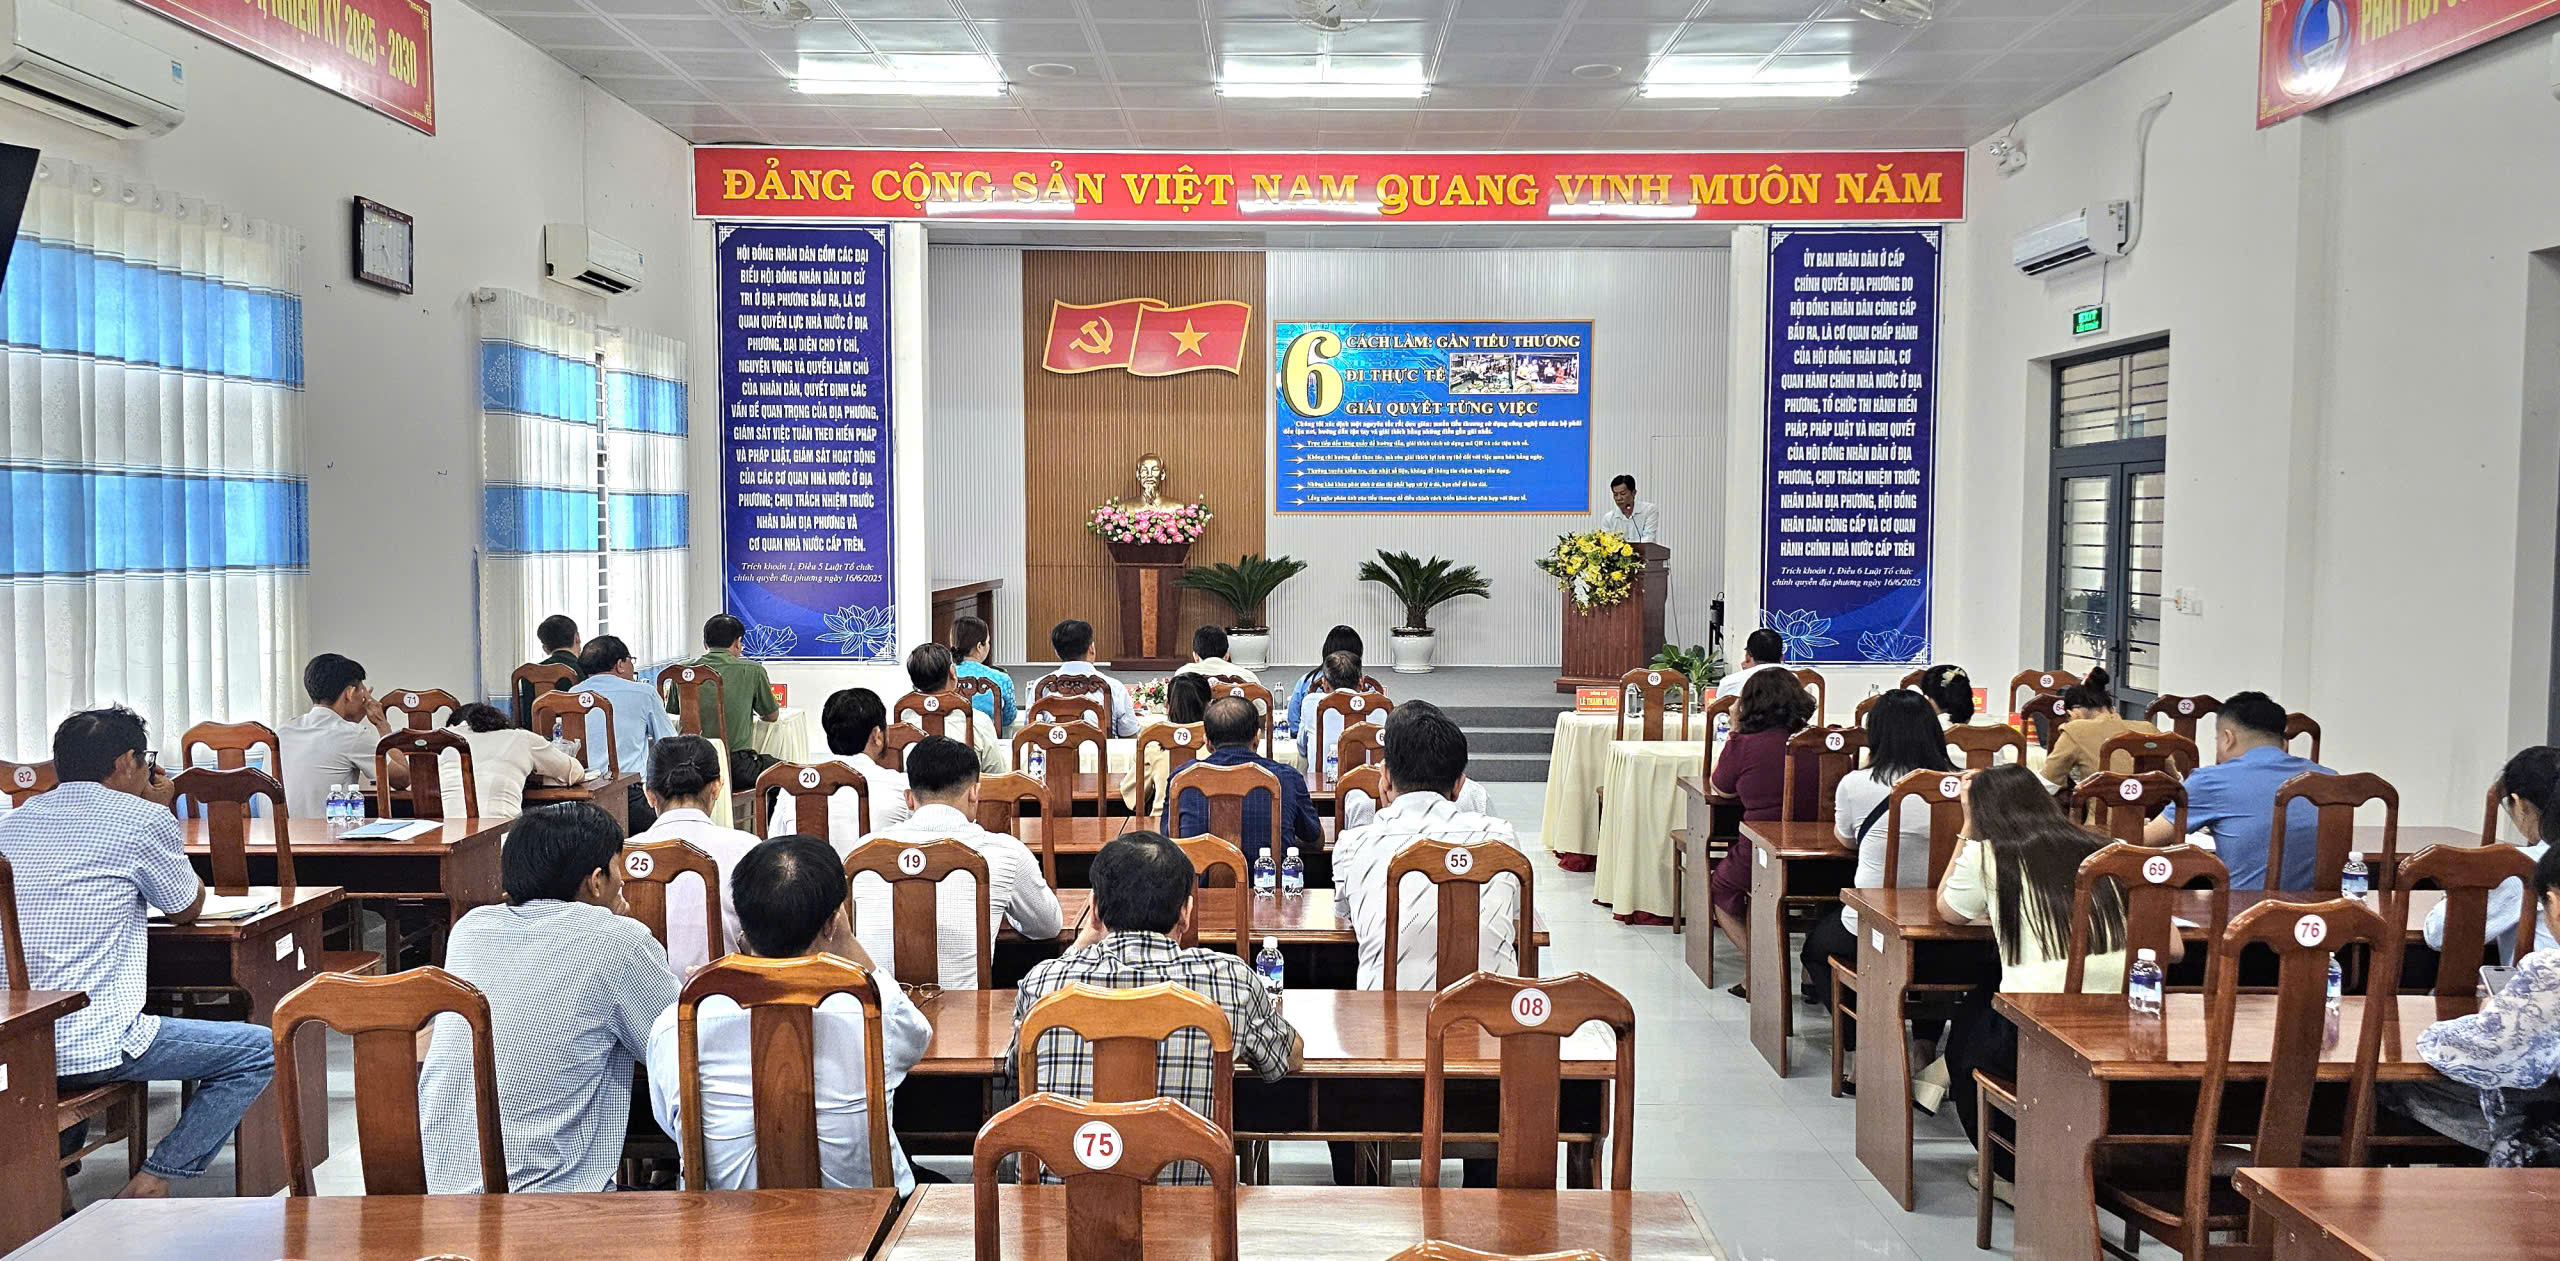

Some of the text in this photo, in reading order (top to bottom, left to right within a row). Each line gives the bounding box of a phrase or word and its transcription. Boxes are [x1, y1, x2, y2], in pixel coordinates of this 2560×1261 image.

[345, 4, 377, 66] 2025
[388, 28, 417, 88] 2030
[723, 158, 1942, 216] ĐẢNG CỘNG SẢN VIỆT NAM QUANG VINH MUÔN NĂM
[737, 244, 750, 263] HỘI
[776, 245, 797, 261] NHÂN
[800, 245, 815, 262] DÂN
[838, 246, 853, 262] CÁC
[855, 249, 868, 265] ĐẠI
[1804, 248, 1904, 267] ỦY BAN NHÂN DÂN Ở CẤP
[741, 264, 758, 283] BIỂU
[761, 267, 774, 287] HỘI
[799, 268, 821, 284] NHÂN
[824, 268, 839, 284] DÂN
[842, 271, 851, 285] DO
[854, 267, 865, 285] CỬ
[1795, 274, 1820, 292] CHÍNH
[1851, 277, 1864, 295] ĐỊA
[1866, 275, 1900, 291] PHƯƠNG
[1902, 277, 1913, 291] DO
[740, 292, 752, 306] TRI
[755, 288, 760, 306] Ở
[762, 292, 775, 309] ĐỊA
[778, 291, 808, 307] PHƯƠNG
[829, 293, 841, 309] RA,
[844, 291, 853, 307] LÀ
[855, 293, 866, 307] CƠ
[1790, 298, 1804, 319] HỘI
[1831, 298, 1854, 316] NHÂN
[1856, 298, 1873, 316] DÂN
[1876, 298, 1897, 316] CÙNG
[1900, 296, 1916, 316] CẤP
[739, 314, 759, 330] QUAN
[789, 314, 803, 332] LỰC
[806, 313, 822, 329] NHÀ
[824, 313, 845, 330] NƯỚC
[847, 312, 852, 330] Ở
[855, 316, 868, 333] ĐỊA
[1807, 326, 1820, 341] RA,
[1822, 323, 1832, 340] LÀ
[1834, 324, 1846, 340] CƠ
[1847, 325, 1869, 341] QUAN
[1872, 321, 1893, 340] CHẤP
[1895, 323, 1918, 340] HÀNH
[1346, 331, 1580, 348] CÁCH LÀM: GẦN TIỂU THƯƠNG
[1794, 345, 1810, 364] CỦA
[1813, 347, 1826, 367] HỘI
[1853, 347, 1876, 364] NHÂN
[1878, 347, 1897, 366] DÂN,
[1900, 348, 1911, 364] CƠ
[1281, 329, 1344, 418] 6
[1345, 366, 1446, 384] ĐI THỰC TẾ
[1345, 398, 1538, 416] GIẢI QUYẾT TỪNG VIỆC
[846, 574, 882, 582] 16/6/2025
[407, 696, 416, 704] 71
[581, 696, 591, 704] 24
[1353, 699, 1362, 707] 73
[1052, 730, 1064, 740] 56
[1177, 731, 1188, 741] 79
[1829, 736, 1841, 746] 78
[18, 771, 32, 782] 82
[803, 772, 816, 783] 20
[1944, 781, 1958, 792] 57
[2124, 784, 2138, 795] 28
[630, 856, 649, 872] 25
[903, 854, 921, 868] 19
[1450, 854, 1468, 868] 55
[2149, 863, 2166, 876] 69
[2301, 922, 2320, 938] 76
[1519, 997, 1543, 1017] 08
[1082, 1133, 1113, 1156] 75
